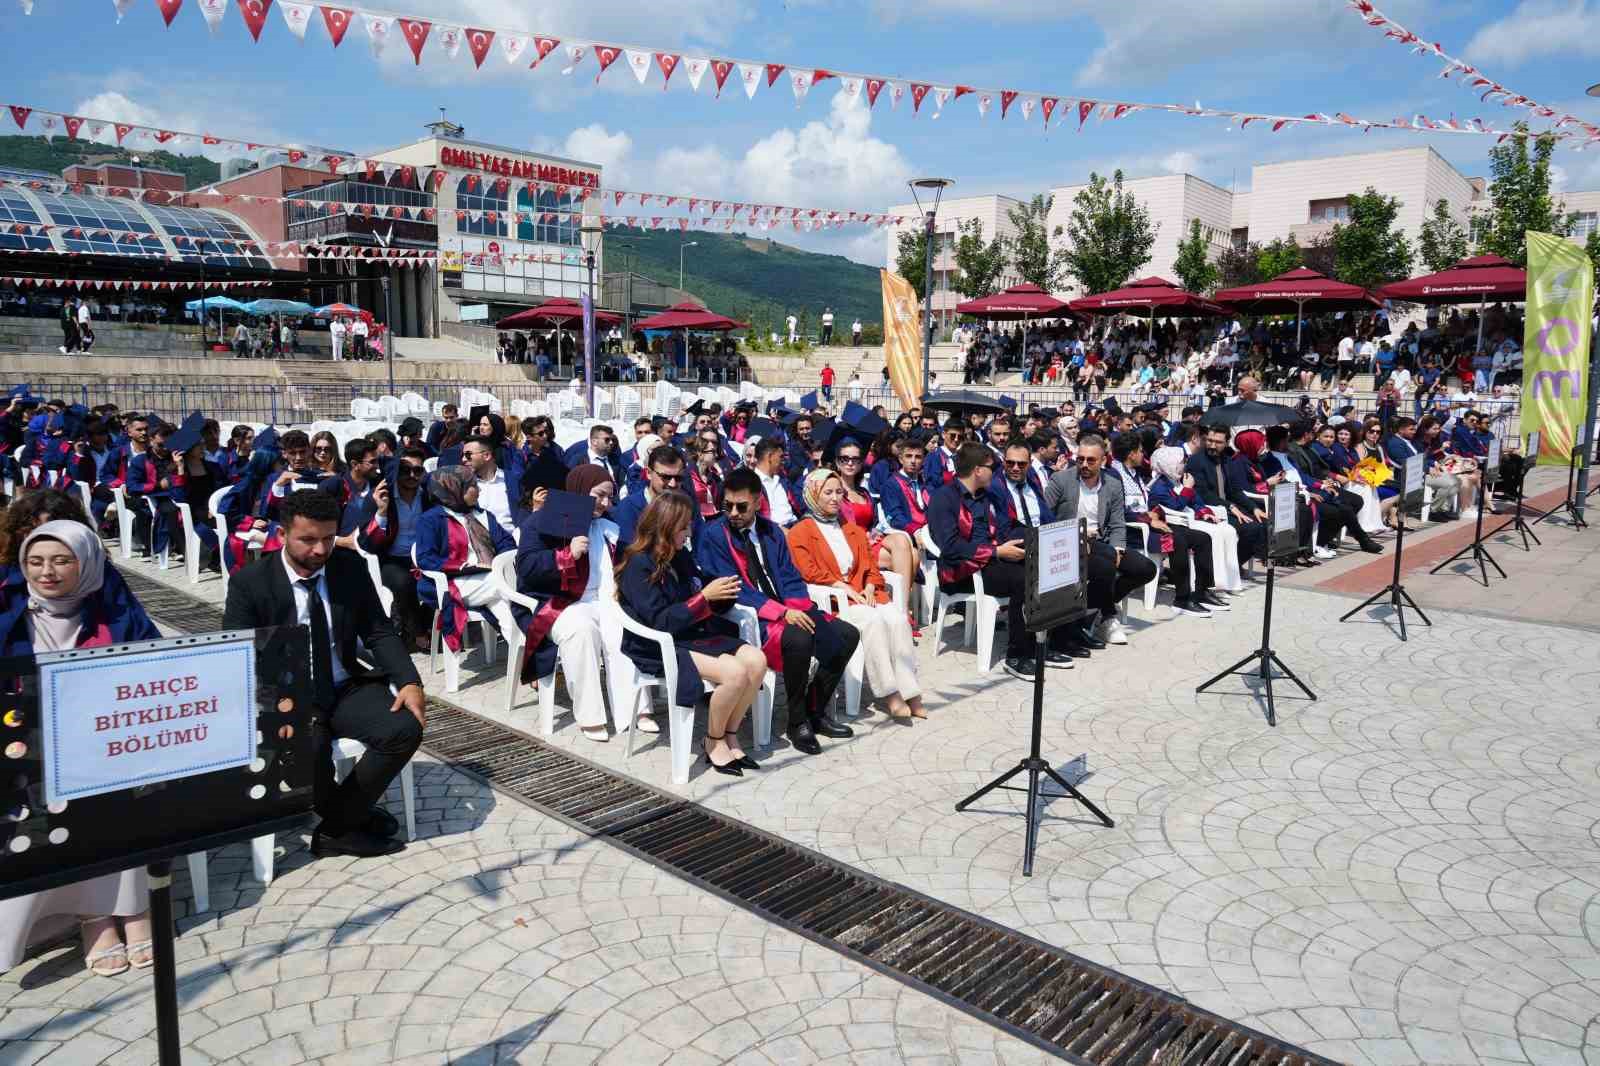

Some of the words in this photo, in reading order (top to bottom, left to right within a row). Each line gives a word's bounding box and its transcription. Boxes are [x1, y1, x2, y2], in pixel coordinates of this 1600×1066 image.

[115, 675, 199, 701] BAHÇE
[95, 695, 220, 732] BİTKİLERİ
[106, 725, 209, 757] BÖLÜMÜ
